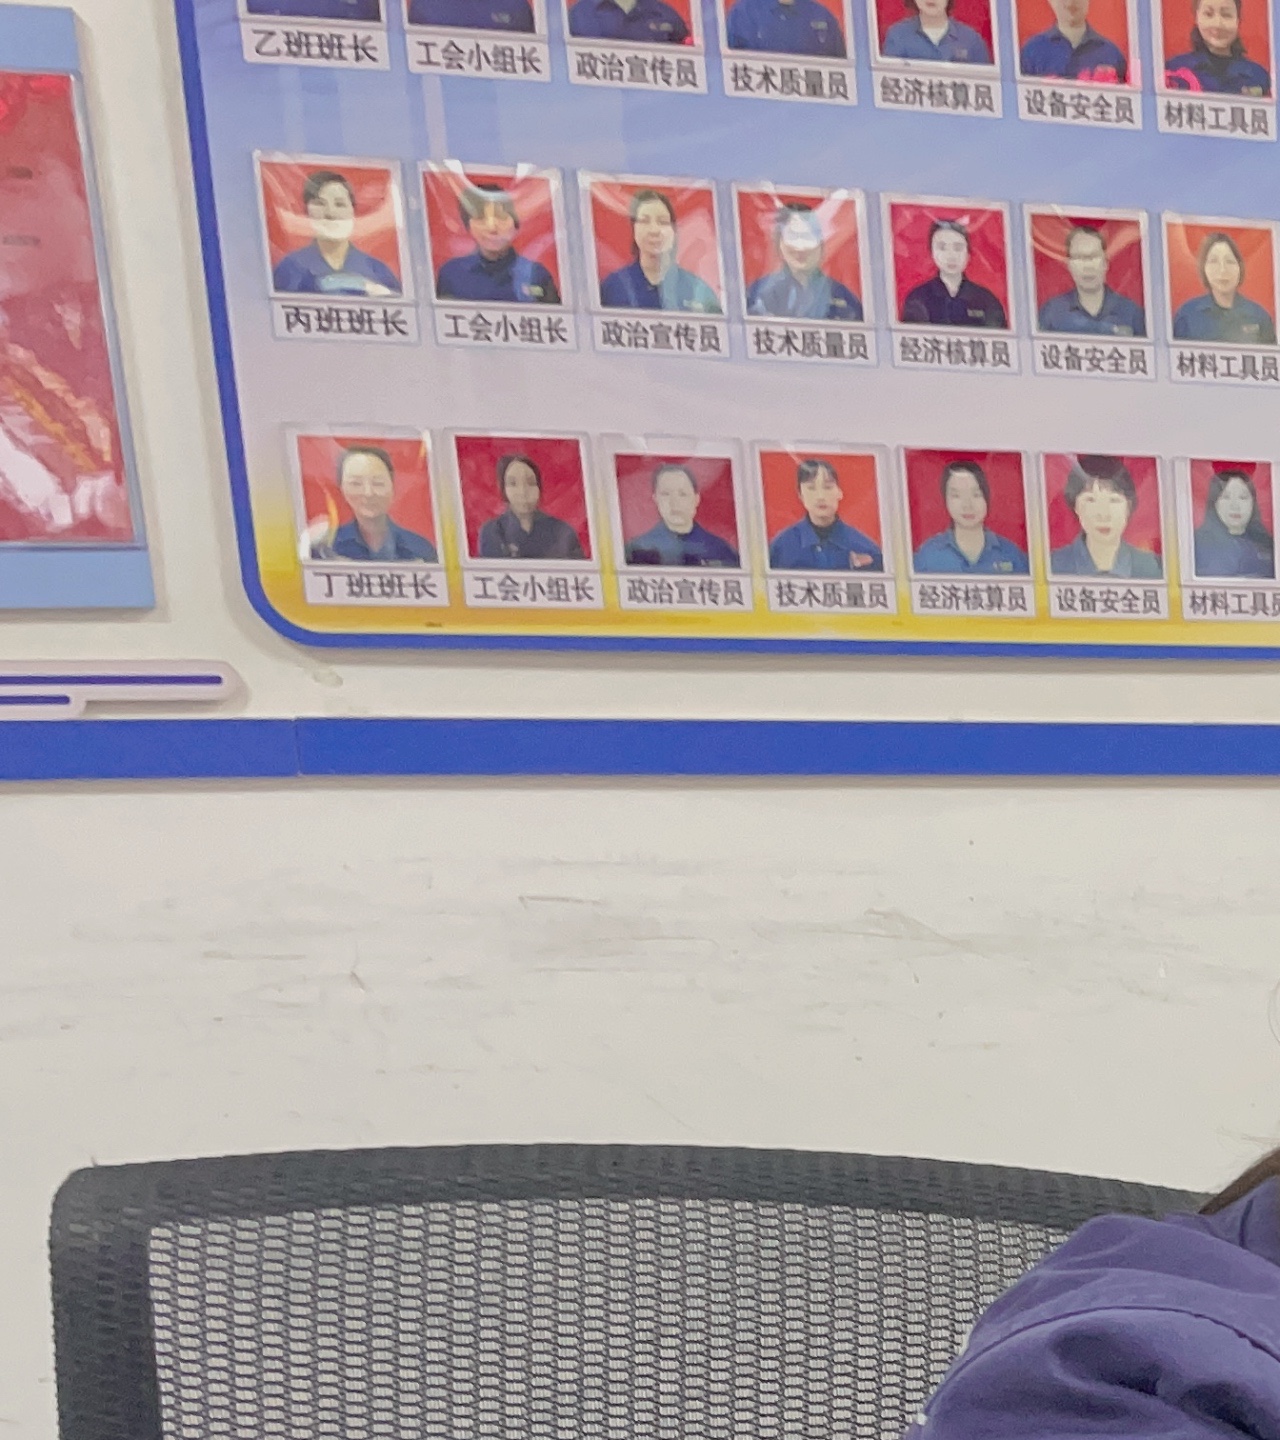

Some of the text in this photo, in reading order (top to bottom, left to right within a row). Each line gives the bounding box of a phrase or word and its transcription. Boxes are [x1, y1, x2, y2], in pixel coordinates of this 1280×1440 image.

[253, 30, 378, 63] 乙班班长
[417, 41, 541, 75] 工会小组长
[577, 50, 697, 87] 政治宣传员
[731, 65, 848, 99] 技术质量员
[881, 77, 993, 112] 经济核算员
[1024, 89, 1134, 125] 设备安全员
[1165, 102, 1269, 137] 材料工具员
[281, 305, 409, 338] 丙班班长
[444, 313, 568, 345] 工会小组长
[601, 320, 721, 353] 政治宣传员
[754, 326, 869, 361] 技术质量员
[900, 336, 1011, 369] 经济核算员
[1041, 344, 1146, 376] 设备安全员
[1176, 351, 1279, 383] 材料工具员
[315, 571, 438, 600] 丁班班长
[473, 575, 593, 603] 工会小组长
[627, 578, 742, 607] 政治宣传员
[777, 579, 888, 610] 技术质量员
[919, 583, 1027, 613] 经济核算员
[1056, 586, 1161, 615] 设备安全员
